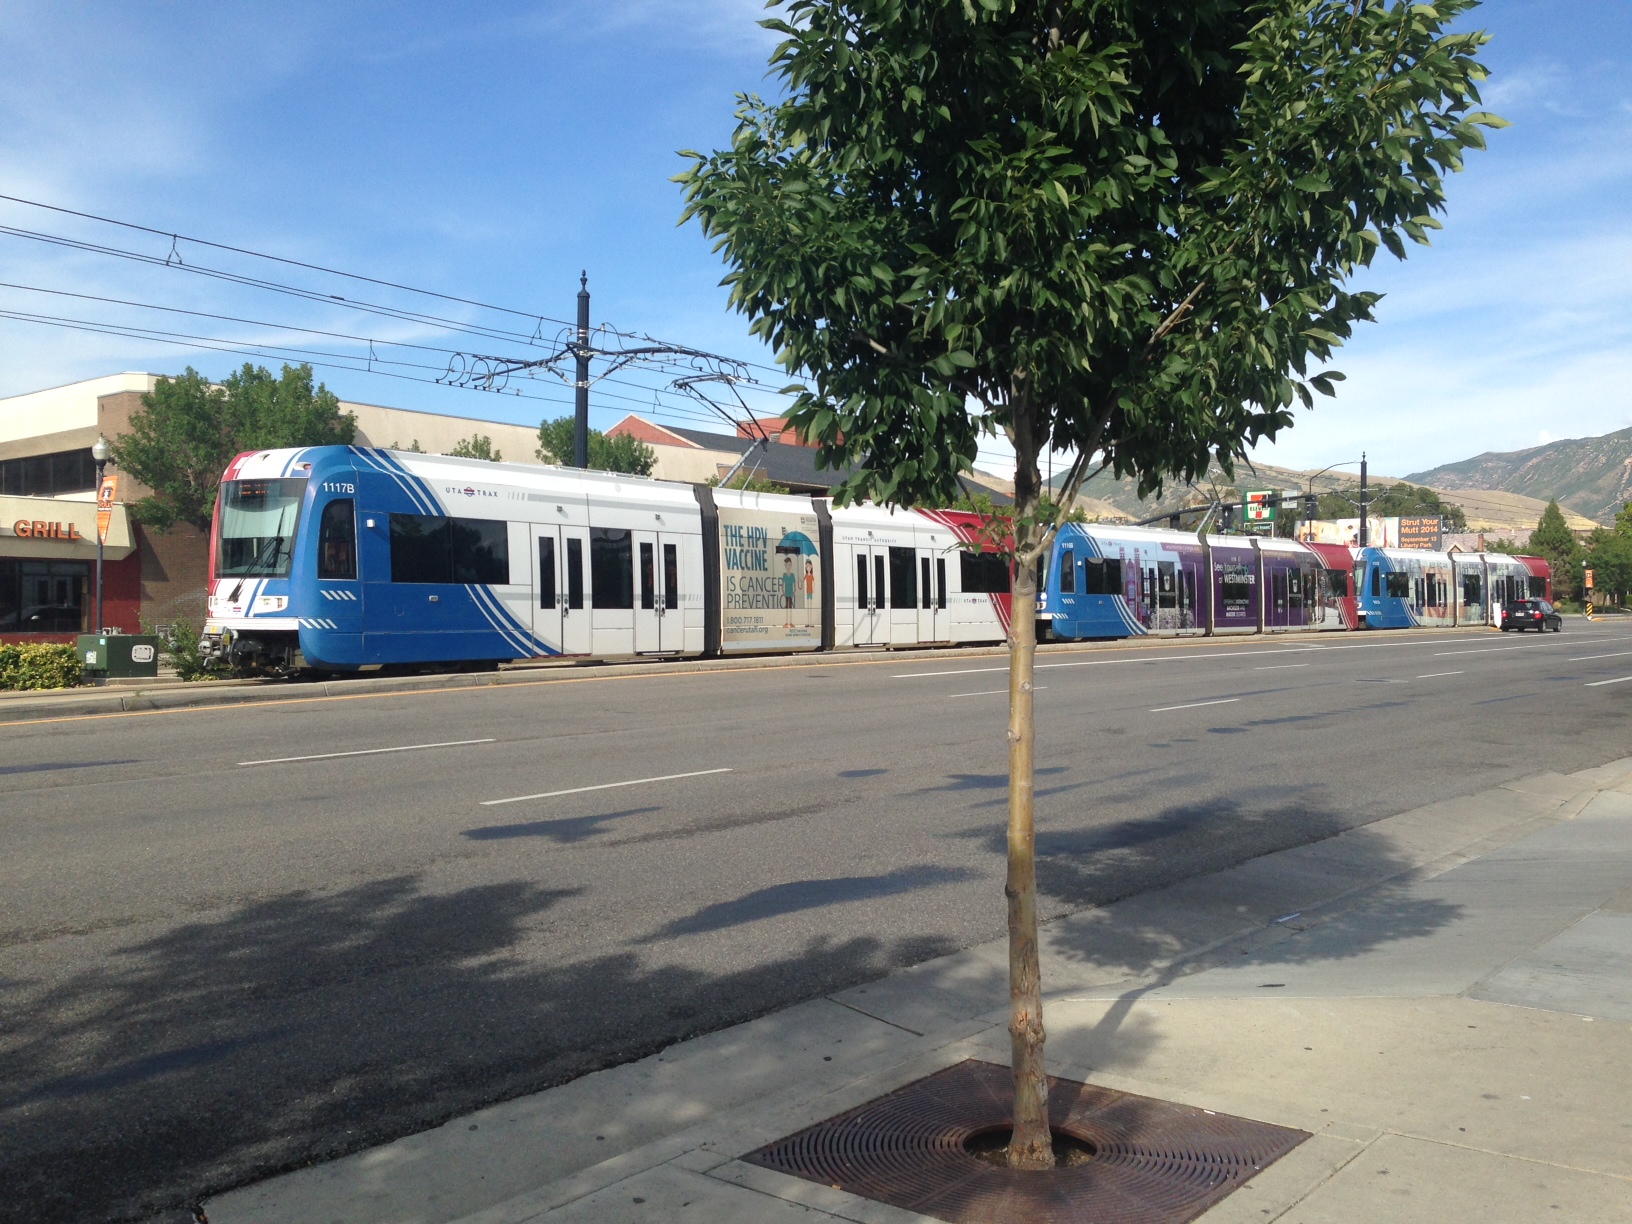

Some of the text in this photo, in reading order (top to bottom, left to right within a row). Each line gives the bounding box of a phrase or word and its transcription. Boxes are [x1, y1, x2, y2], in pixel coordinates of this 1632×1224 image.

[322, 482, 355, 494] 1117B
[477, 489, 498, 497] TRAX
[14, 519, 82, 540] GRILL
[723, 525, 767, 548] THE HPV
[724, 548, 768, 571] VACCINE
[1214, 562, 1223, 571] See
[726, 575, 784, 593] IS CANCER
[1223, 574, 1255, 584] WESTMINSTER
